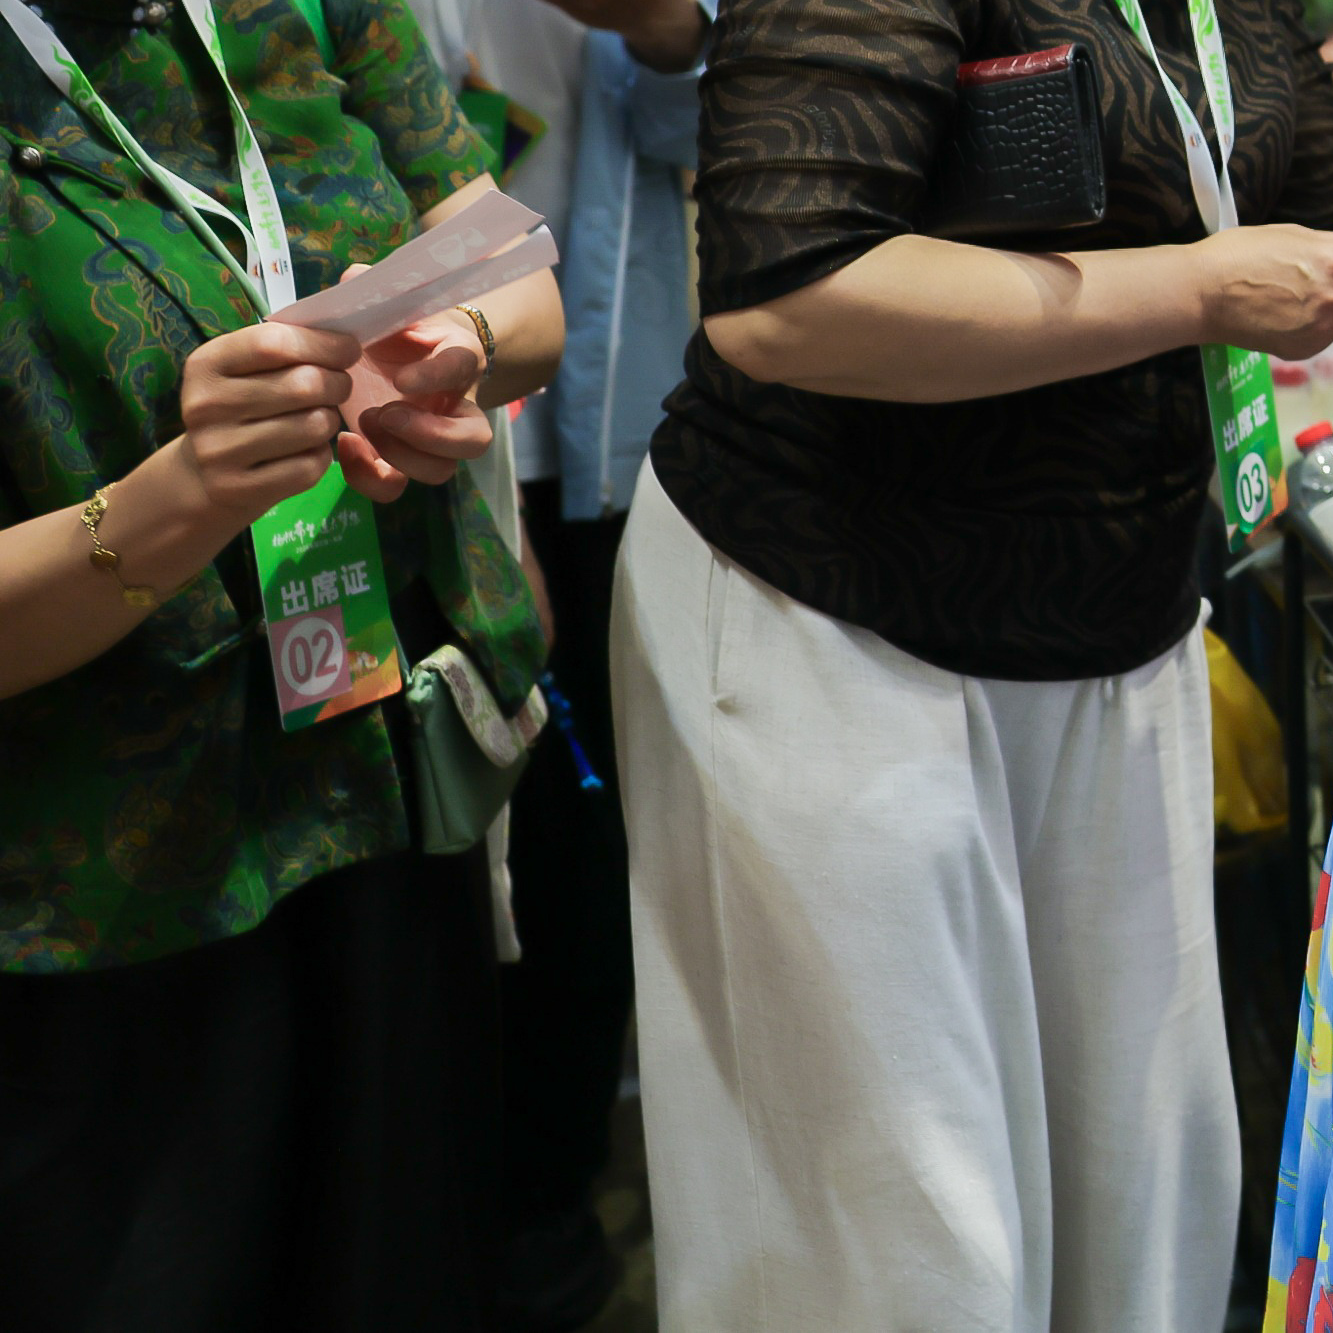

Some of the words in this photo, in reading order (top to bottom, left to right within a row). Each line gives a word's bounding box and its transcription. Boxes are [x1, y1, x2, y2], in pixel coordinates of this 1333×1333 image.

[1240, 463, 1264, 513] 03
[280, 560, 371, 616] 出席证
[288, 629, 338, 685] 02
